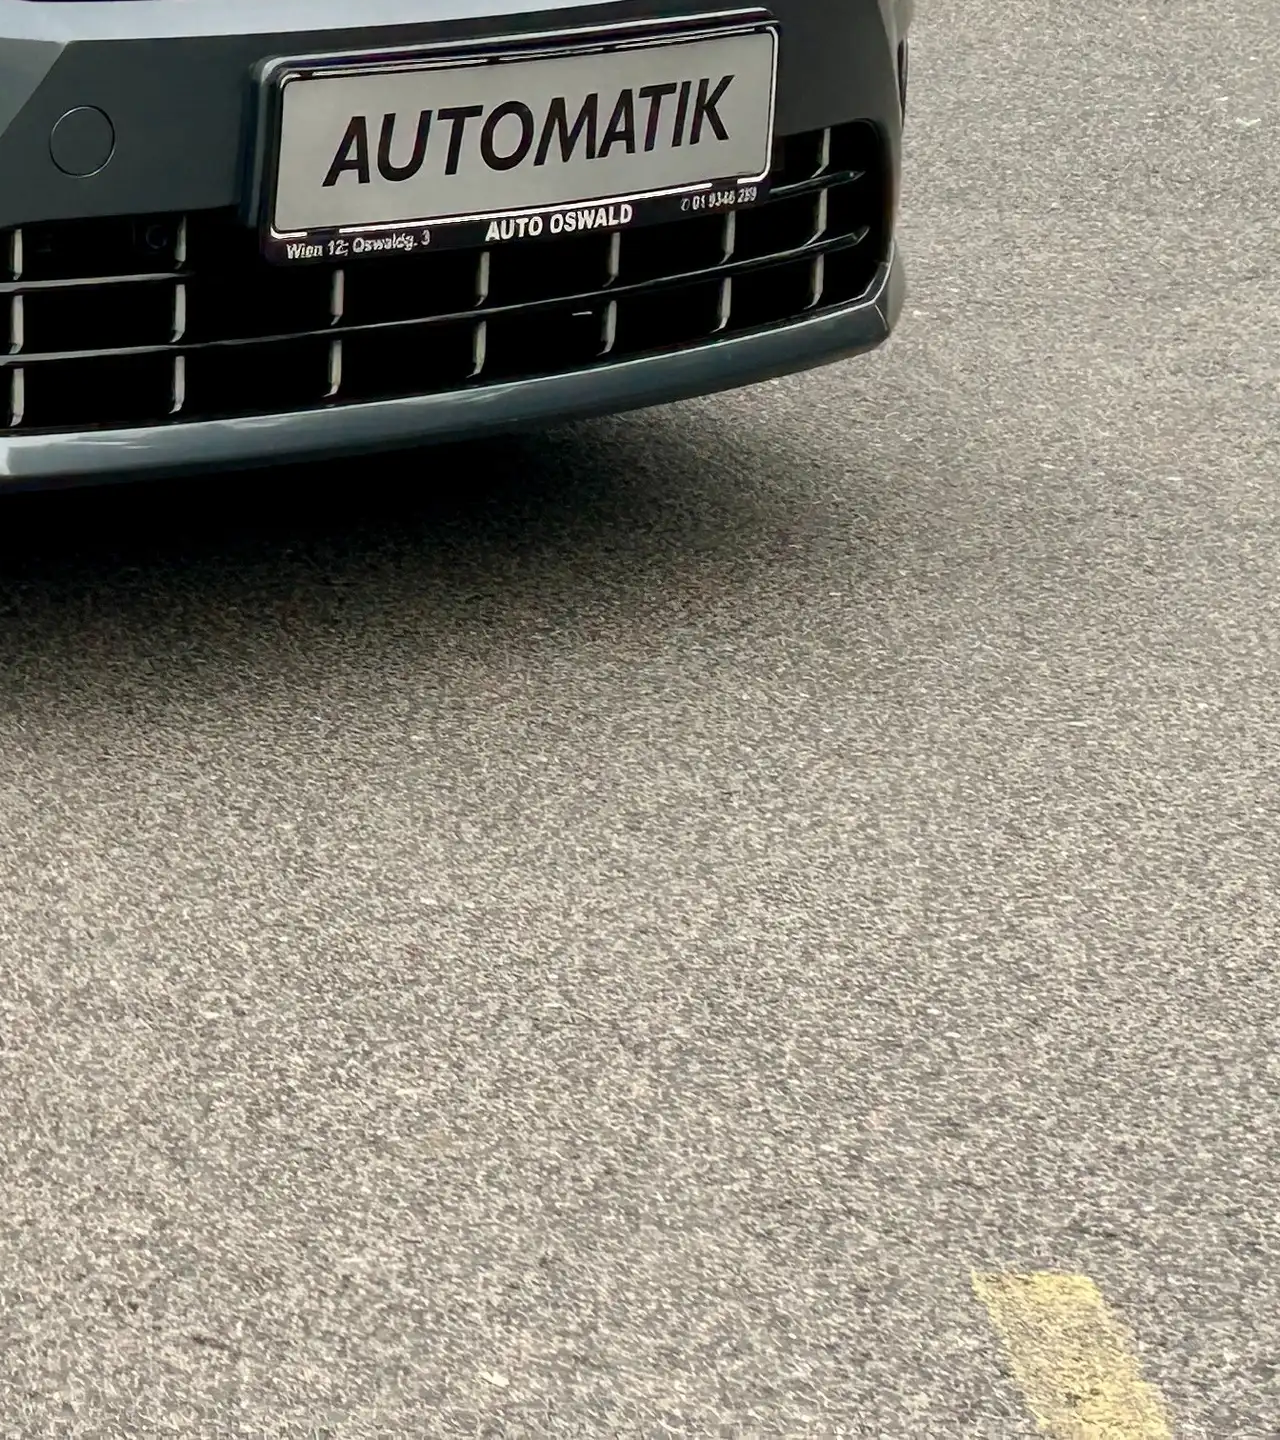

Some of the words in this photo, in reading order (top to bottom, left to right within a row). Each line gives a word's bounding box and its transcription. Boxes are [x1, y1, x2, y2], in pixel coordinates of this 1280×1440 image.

[321, 74, 736, 187] AUTOMATIK
[484, 216, 544, 242] AUTO
[549, 204, 633, 234] OSWALD
[285, 242, 324, 260] Wien
[421, 229, 431, 246] 3
